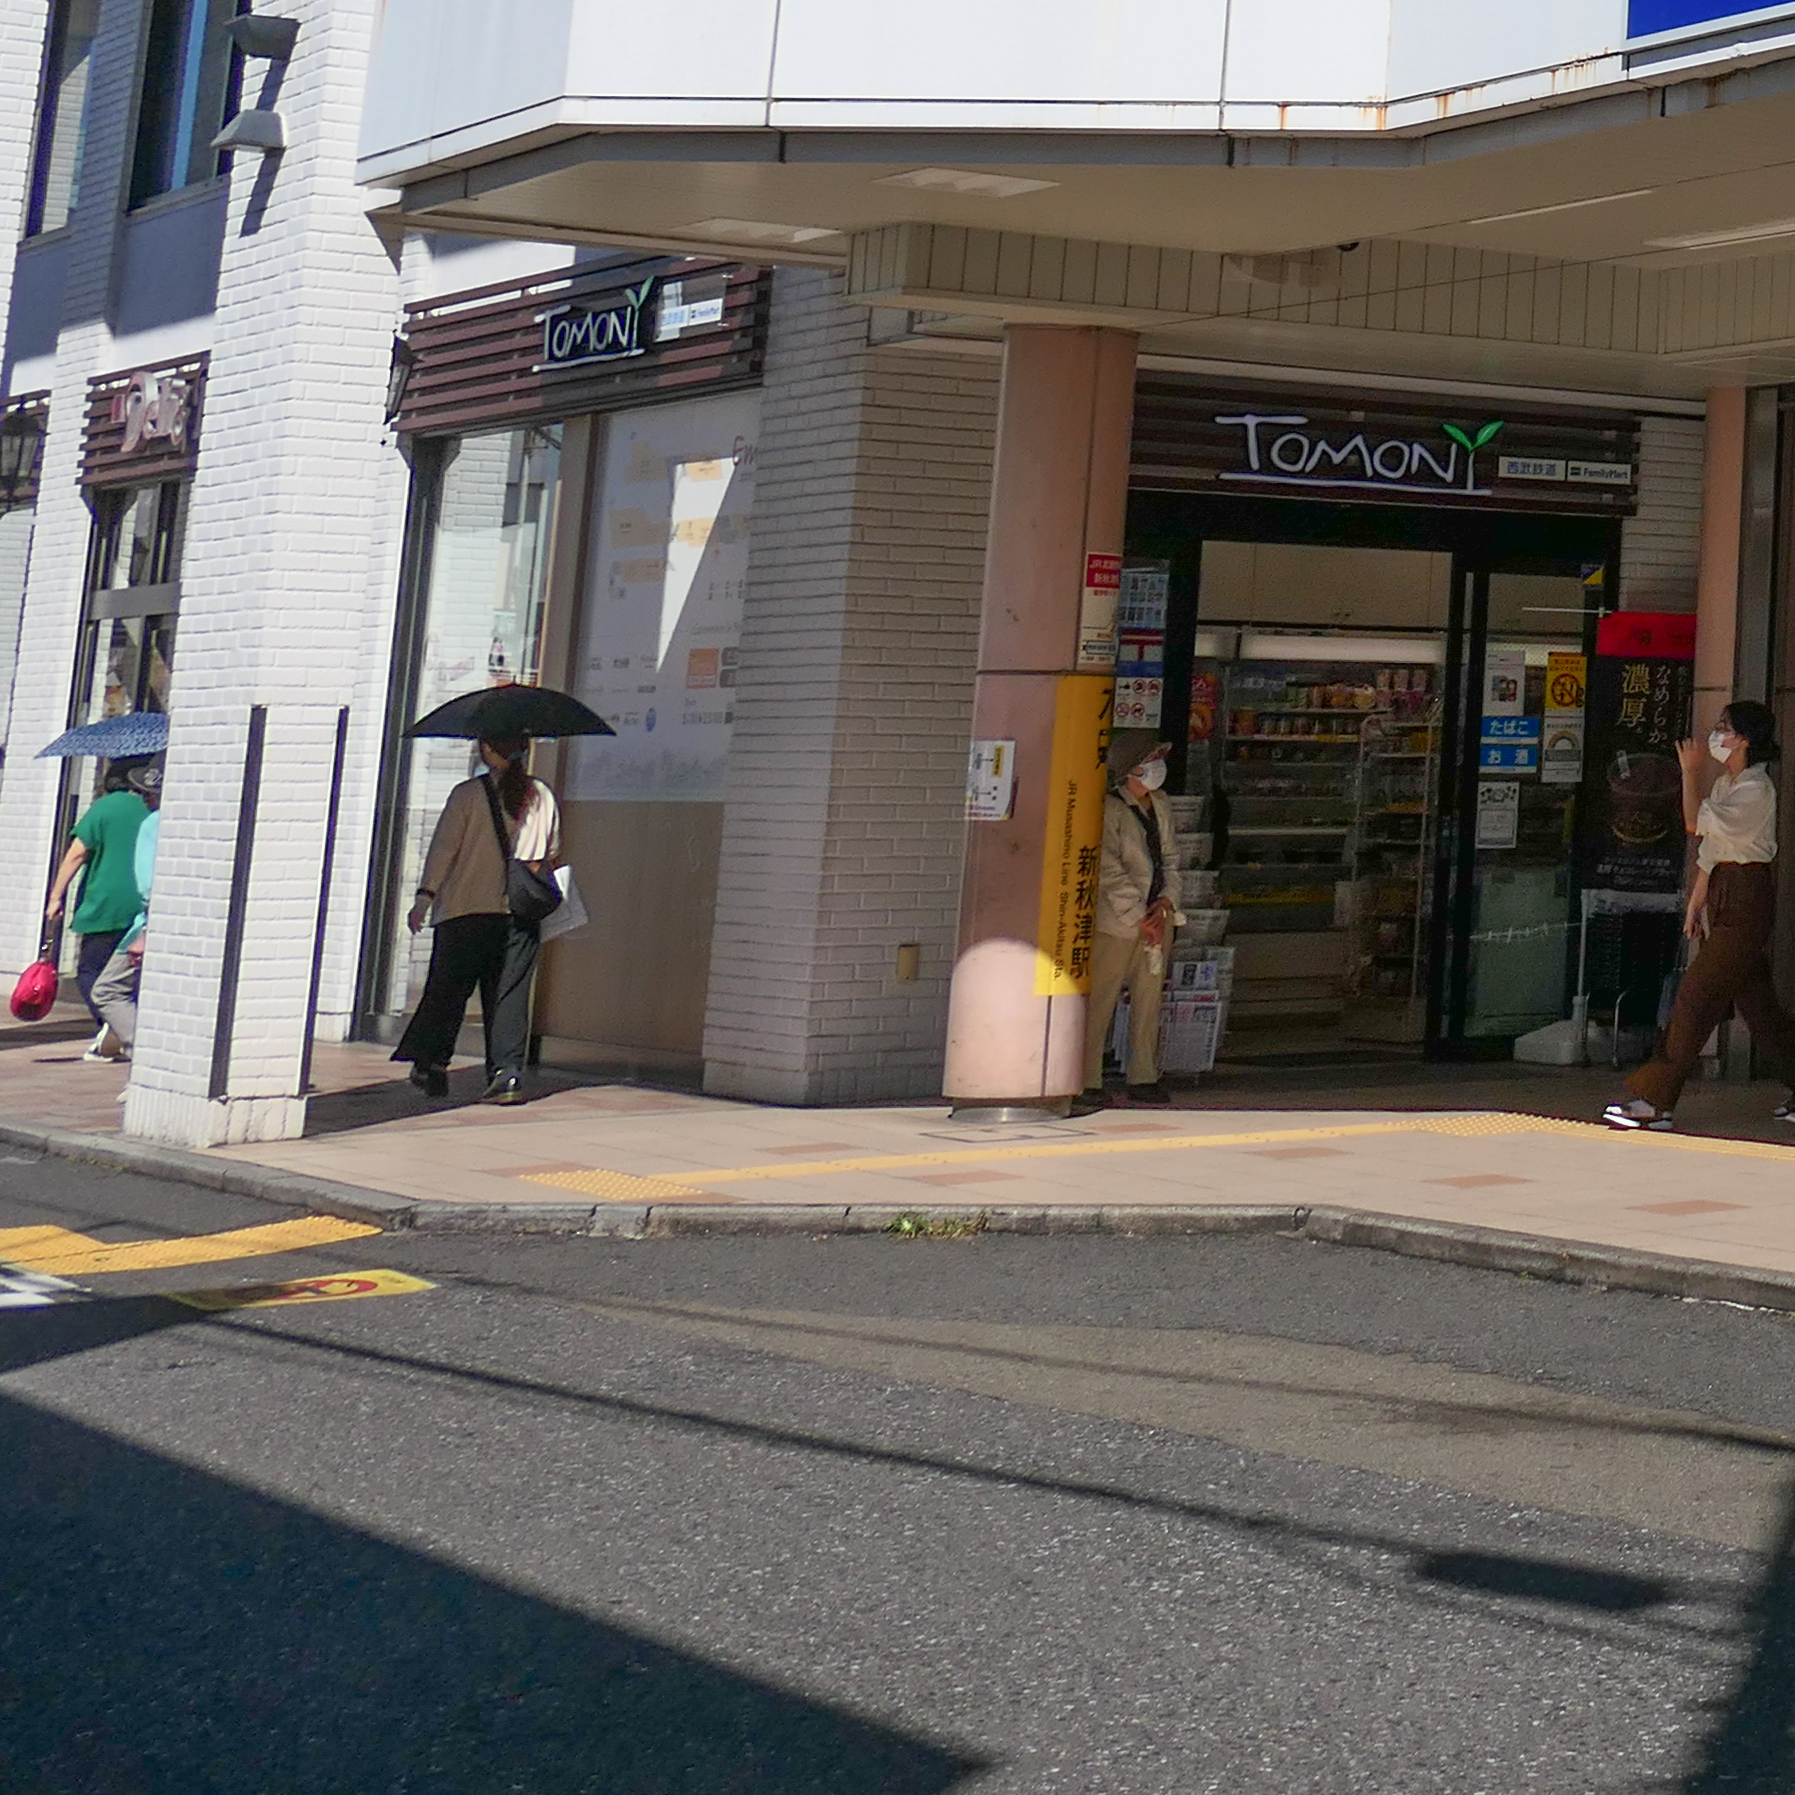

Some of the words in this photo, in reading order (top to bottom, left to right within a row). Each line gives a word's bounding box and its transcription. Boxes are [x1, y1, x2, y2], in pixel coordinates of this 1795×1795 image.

[534, 275, 655, 368] TOMONY
[1214, 412, 1504, 495] TOMONY
[1583, 466, 1629, 480] FamilyMart
[1488, 718, 1531, 737] たばこ
